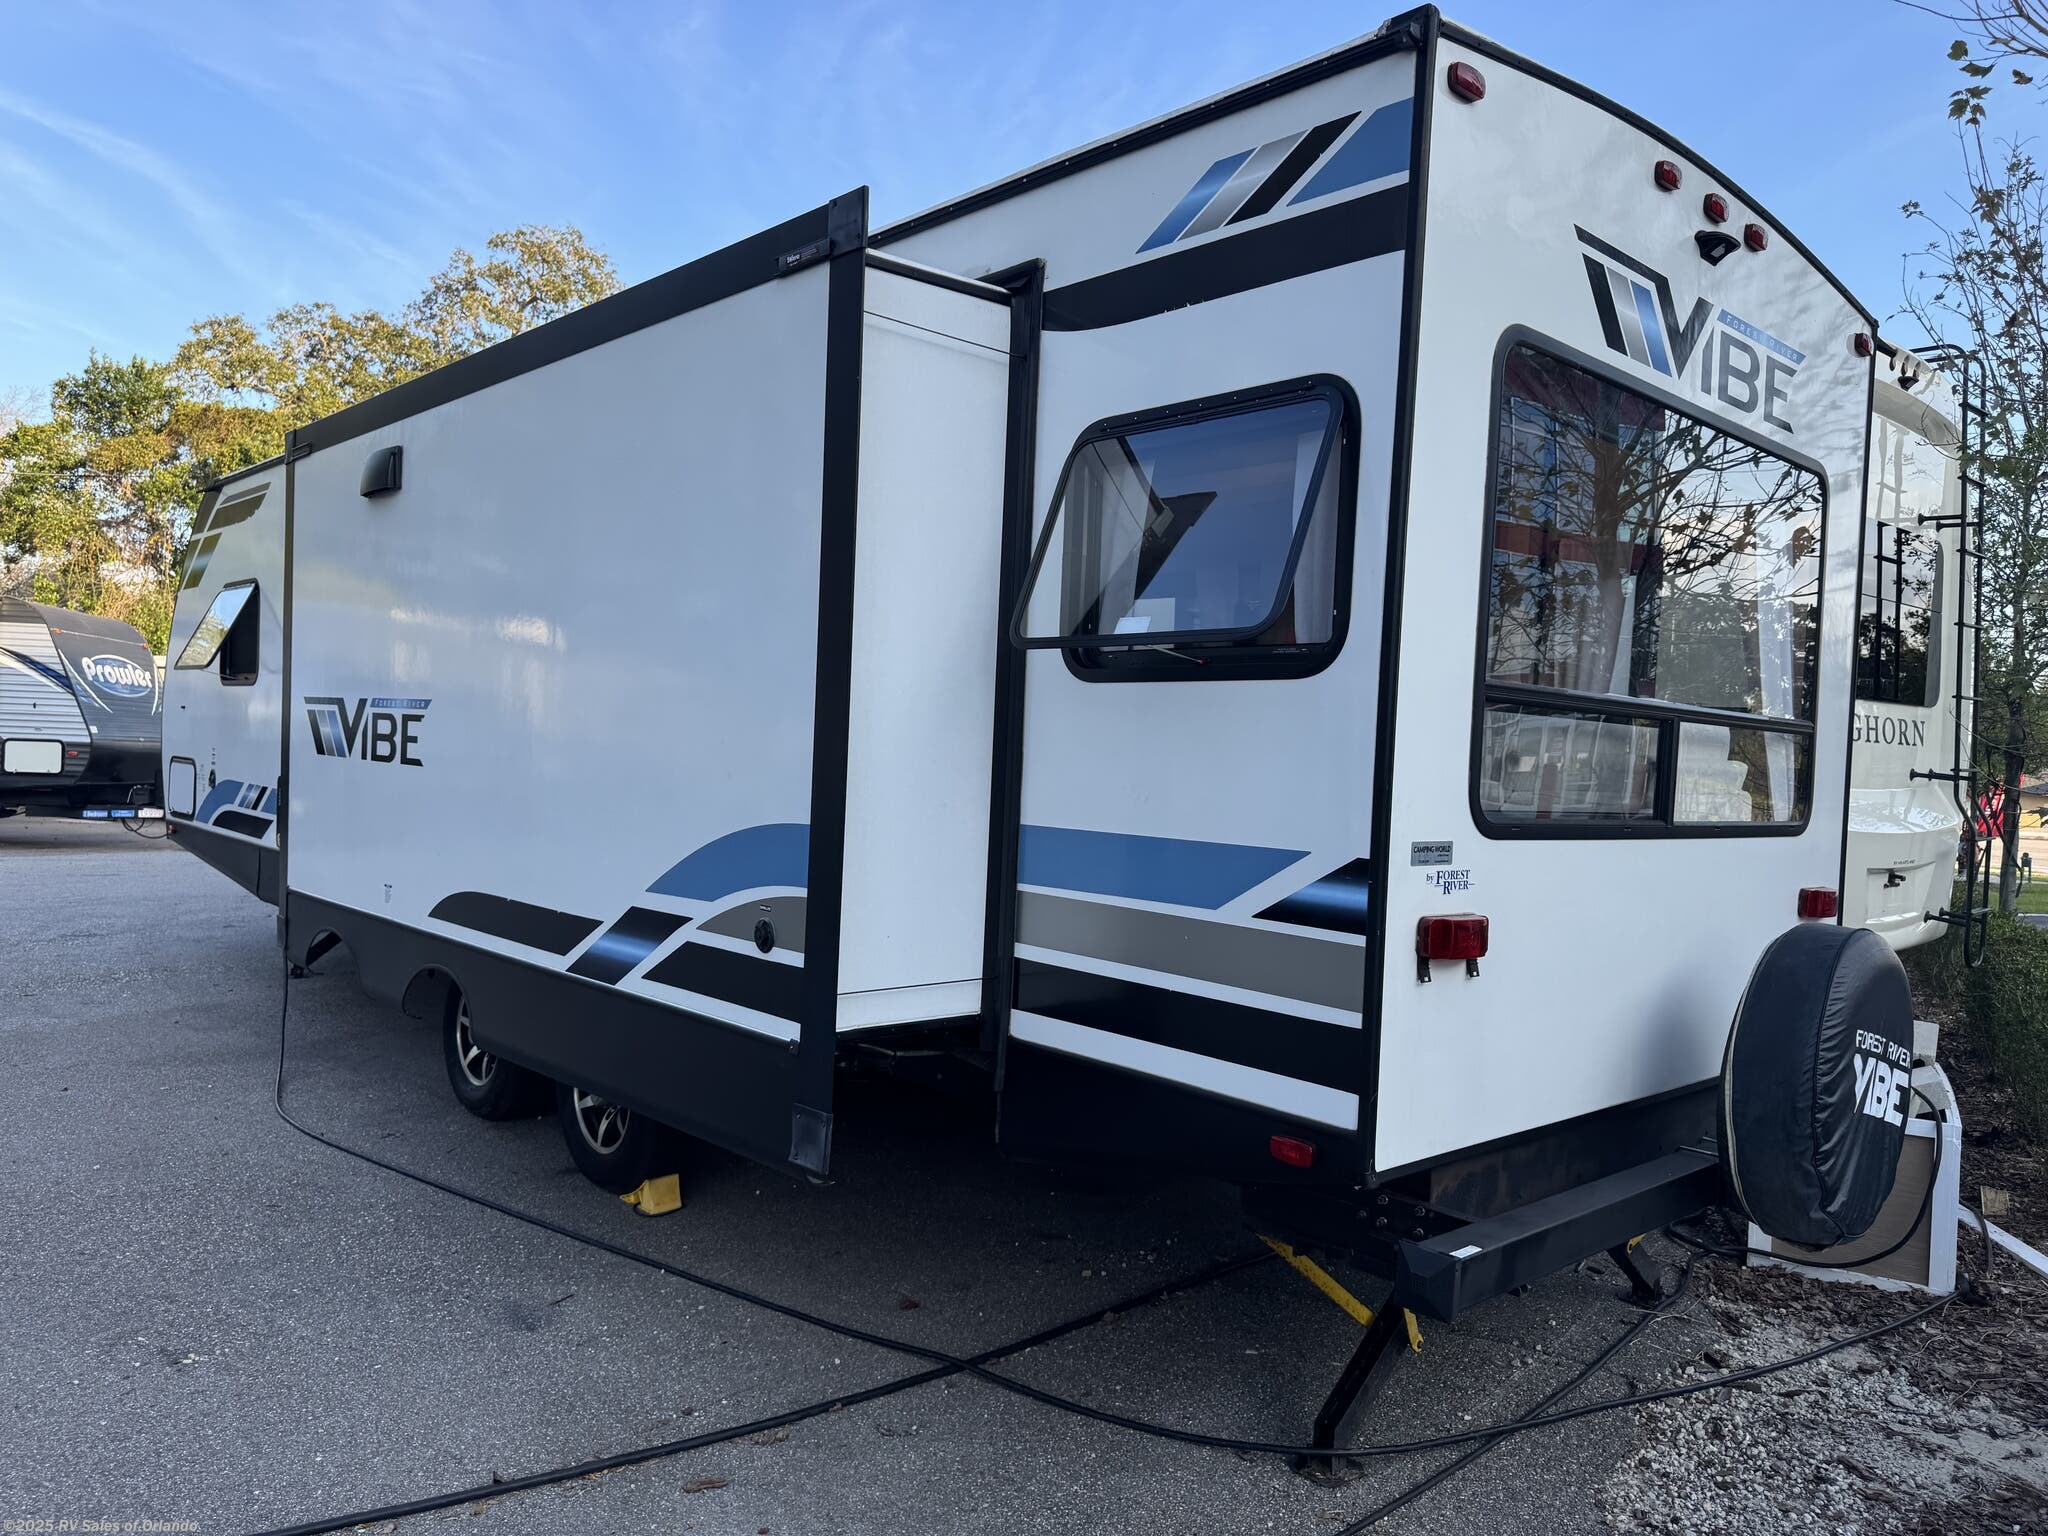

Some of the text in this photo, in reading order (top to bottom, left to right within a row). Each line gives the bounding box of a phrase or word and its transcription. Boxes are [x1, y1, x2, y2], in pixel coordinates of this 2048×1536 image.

[1574, 223, 1798, 434] VIBE
[82, 657, 153, 688] Prowler
[304, 697, 425, 767] VIBE
[1426, 869, 1470, 884] by FOREST
[1443, 880, 1469, 894] RIVER
[1856, 1029, 1886, 1055] FOREST
[1853, 1052, 1910, 1128] VIBE
